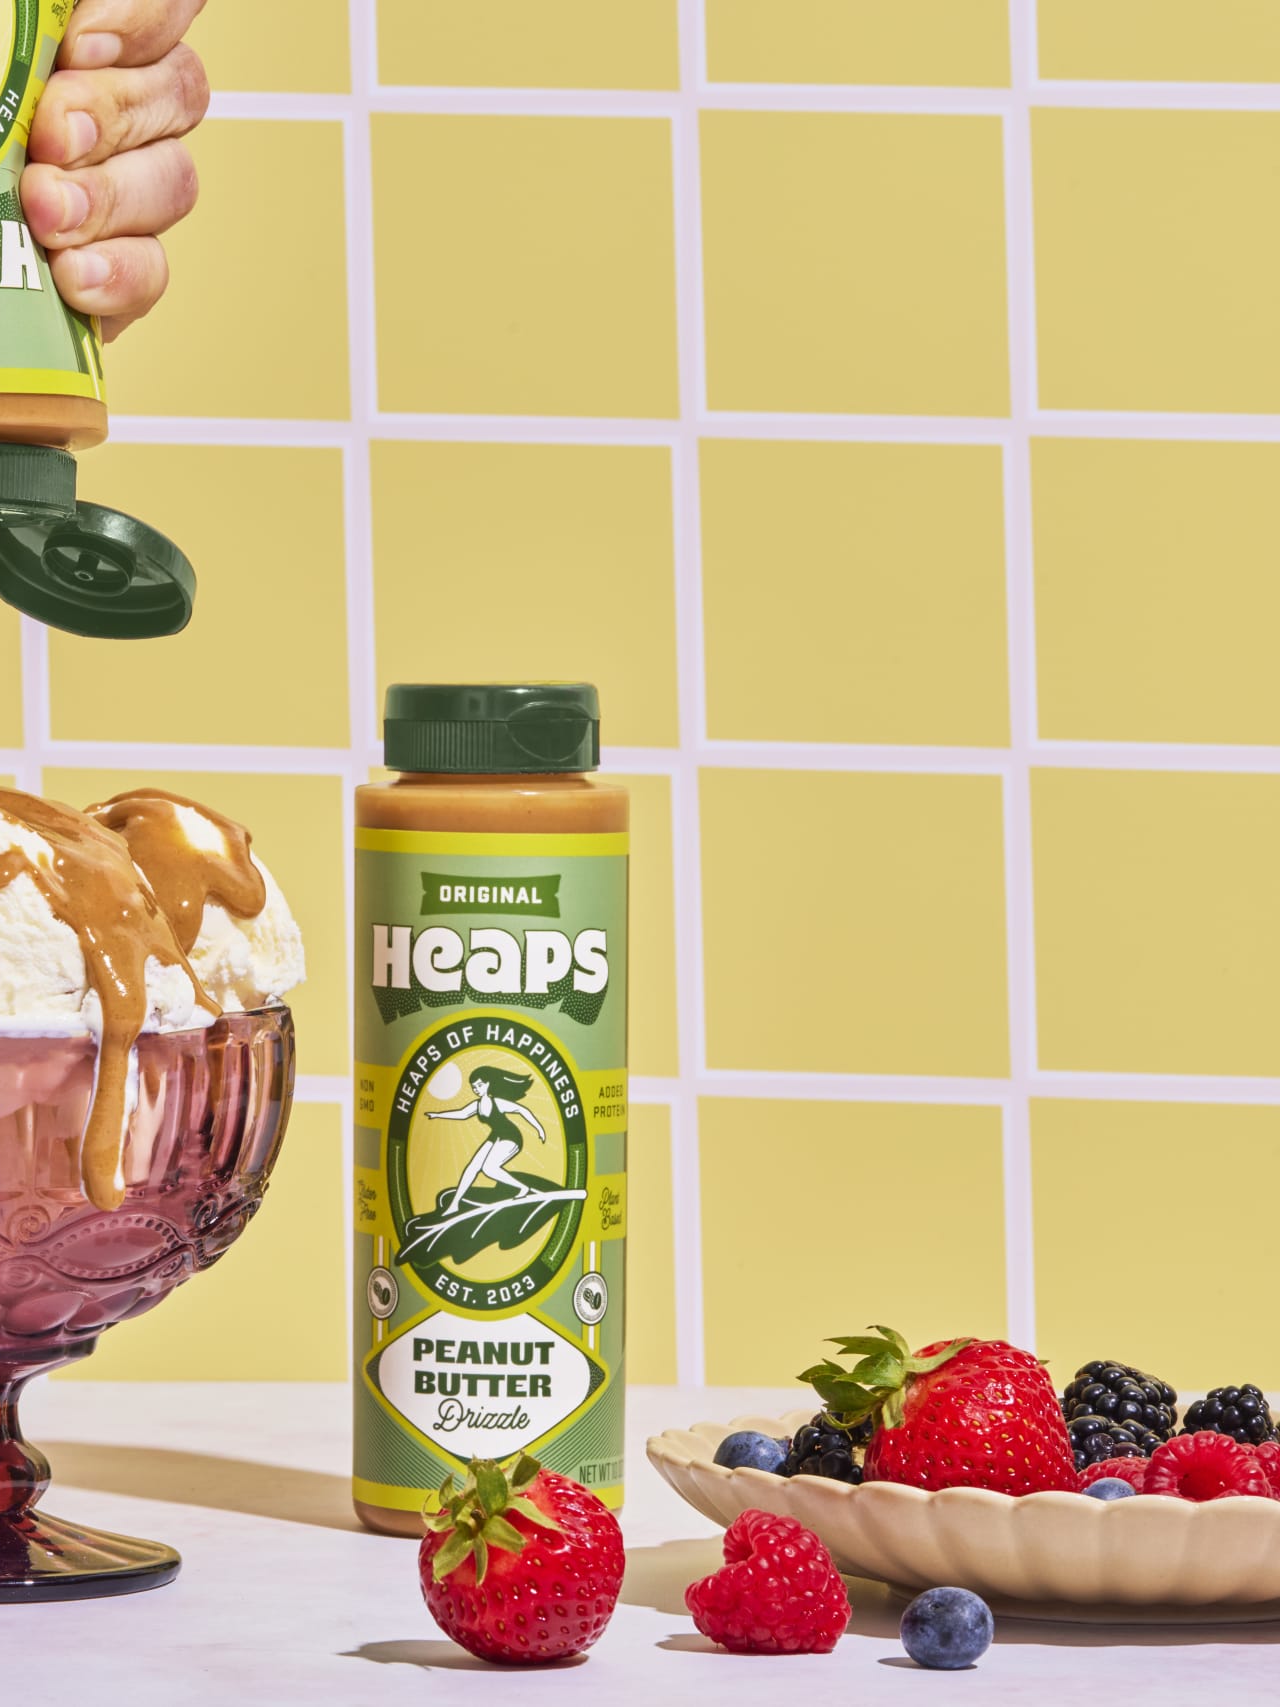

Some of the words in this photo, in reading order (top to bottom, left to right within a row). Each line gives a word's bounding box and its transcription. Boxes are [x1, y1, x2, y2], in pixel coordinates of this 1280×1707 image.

[439, 884, 543, 904] ORIGINAL
[396, 1044, 442, 1114] HEAPS
[446, 1025, 474, 1049] OF
[486, 1024, 579, 1118] HAPPINESS
[599, 1084, 624, 1098] ADDED
[435, 1274, 476, 1304] EST.
[487, 1275, 535, 1304] 2023
[412, 1337, 555, 1366] PEANUT
[414, 1370, 552, 1397] BUTTER
[432, 1397, 531, 1432] Drizzle
[580, 1464, 597, 1484] NET
[599, 1462, 611, 1482] WT
